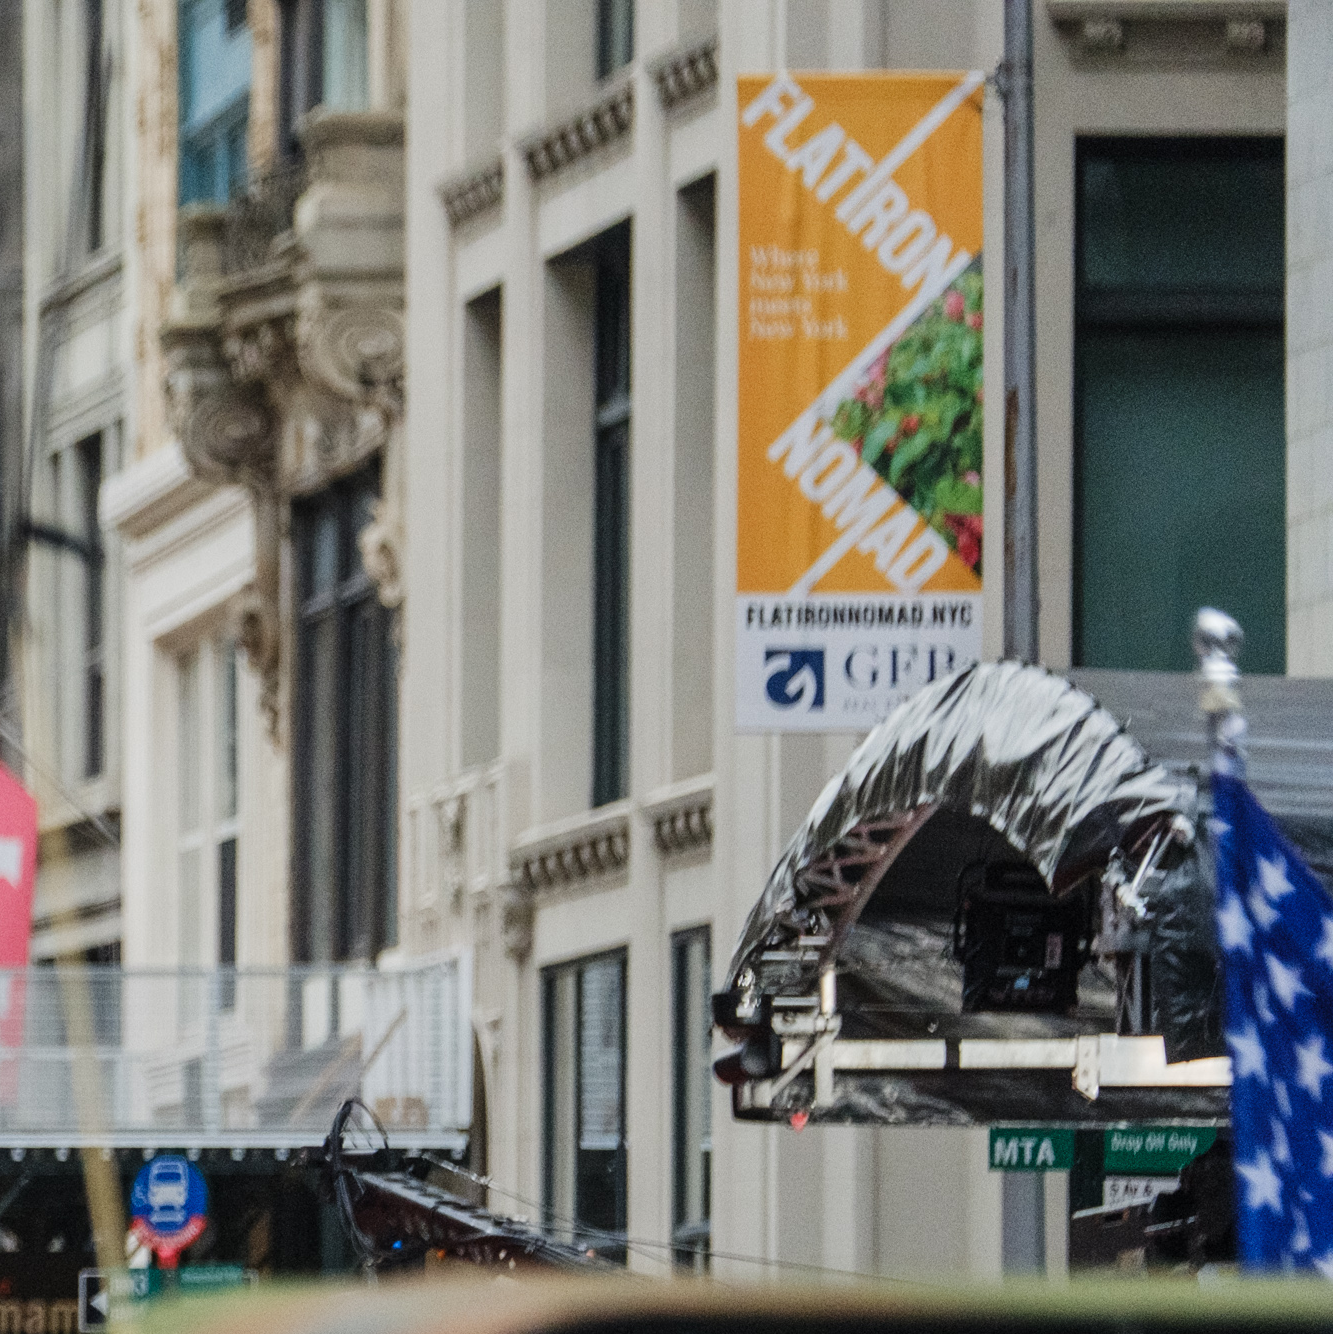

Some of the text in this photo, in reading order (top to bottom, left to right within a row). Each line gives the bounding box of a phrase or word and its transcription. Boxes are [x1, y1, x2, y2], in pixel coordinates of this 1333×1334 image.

[741, 76, 972, 292] FLATIRON
[767, 408, 949, 597] NOMAD
[746, 601, 973, 629] FLATIRONNOMAD.NYC
[993, 1137, 1056, 1166] MTA
